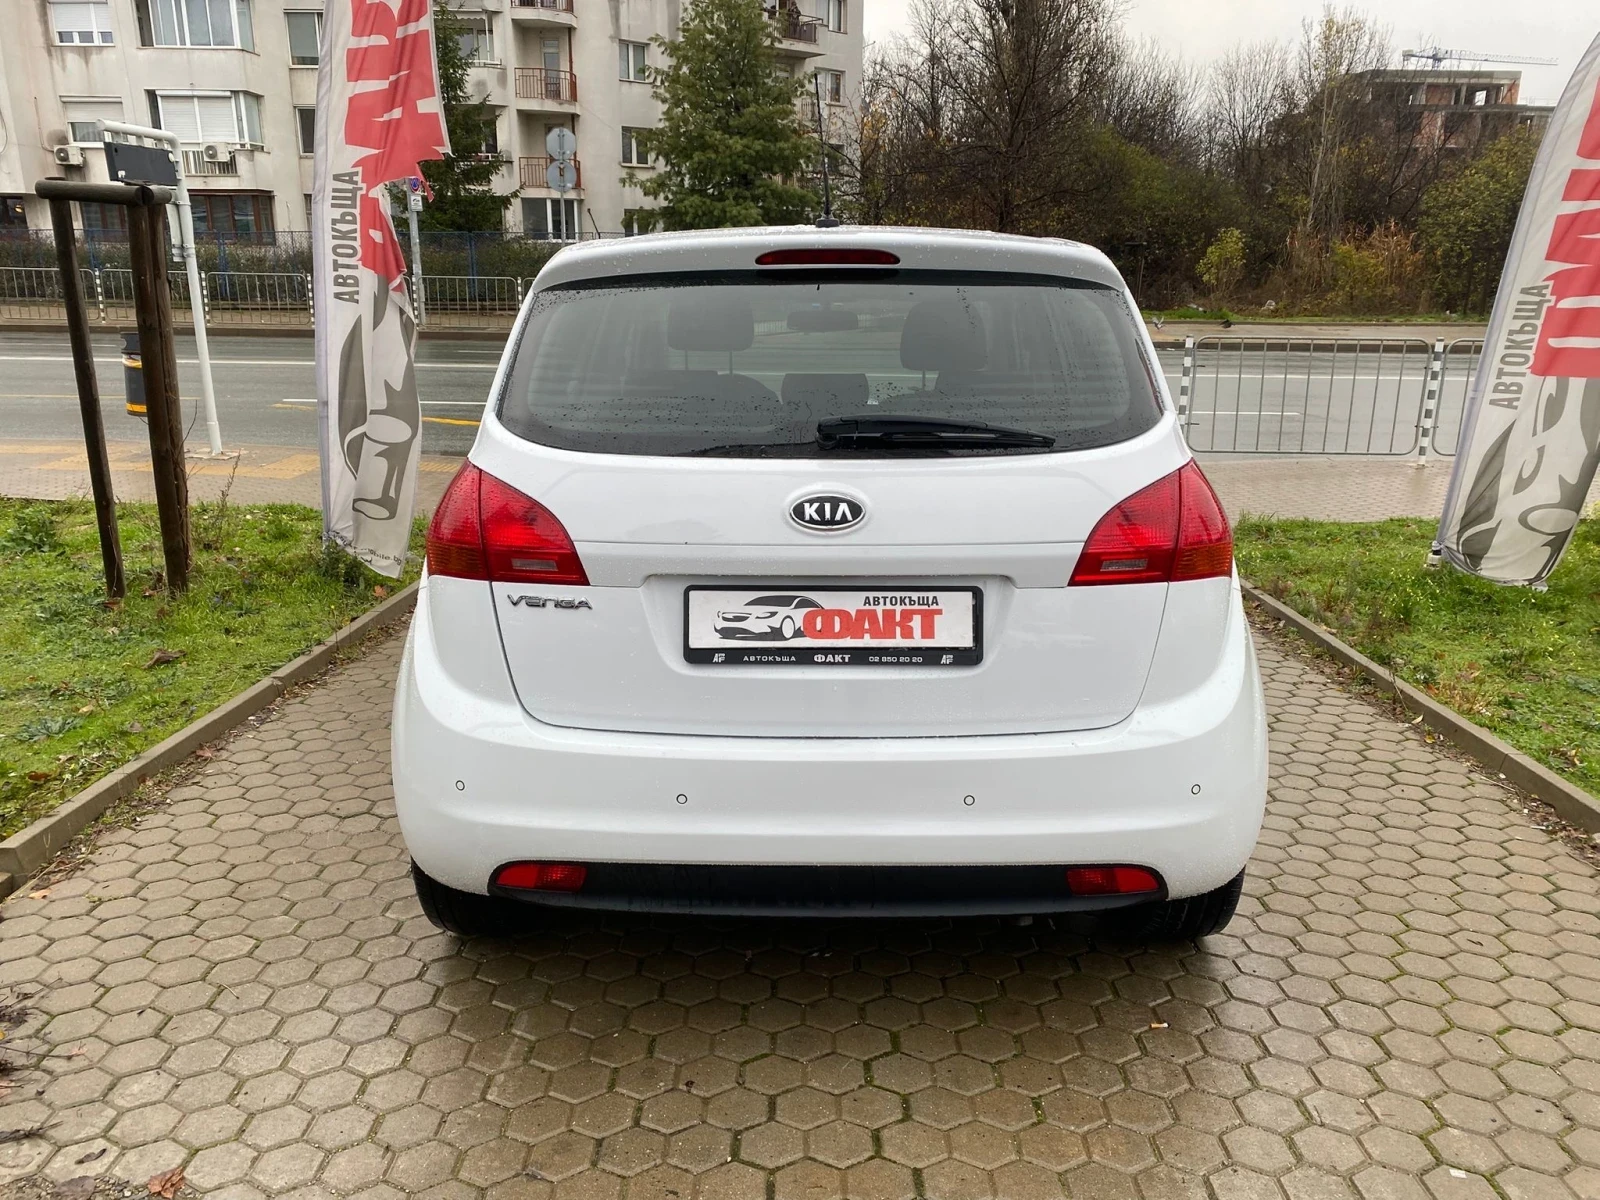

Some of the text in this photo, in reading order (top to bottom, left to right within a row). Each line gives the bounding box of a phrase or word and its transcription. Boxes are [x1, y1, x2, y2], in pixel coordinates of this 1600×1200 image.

[331, 170, 363, 304] АВТОКЪЩА
[1489, 283, 1552, 410] АВТОКЪЩА
[803, 502, 853, 521] KIA
[863, 595, 939, 608] АВТОКЪЩА
[802, 608, 943, 640] ФАКТ
[813, 653, 851, 663] ФАКТ
